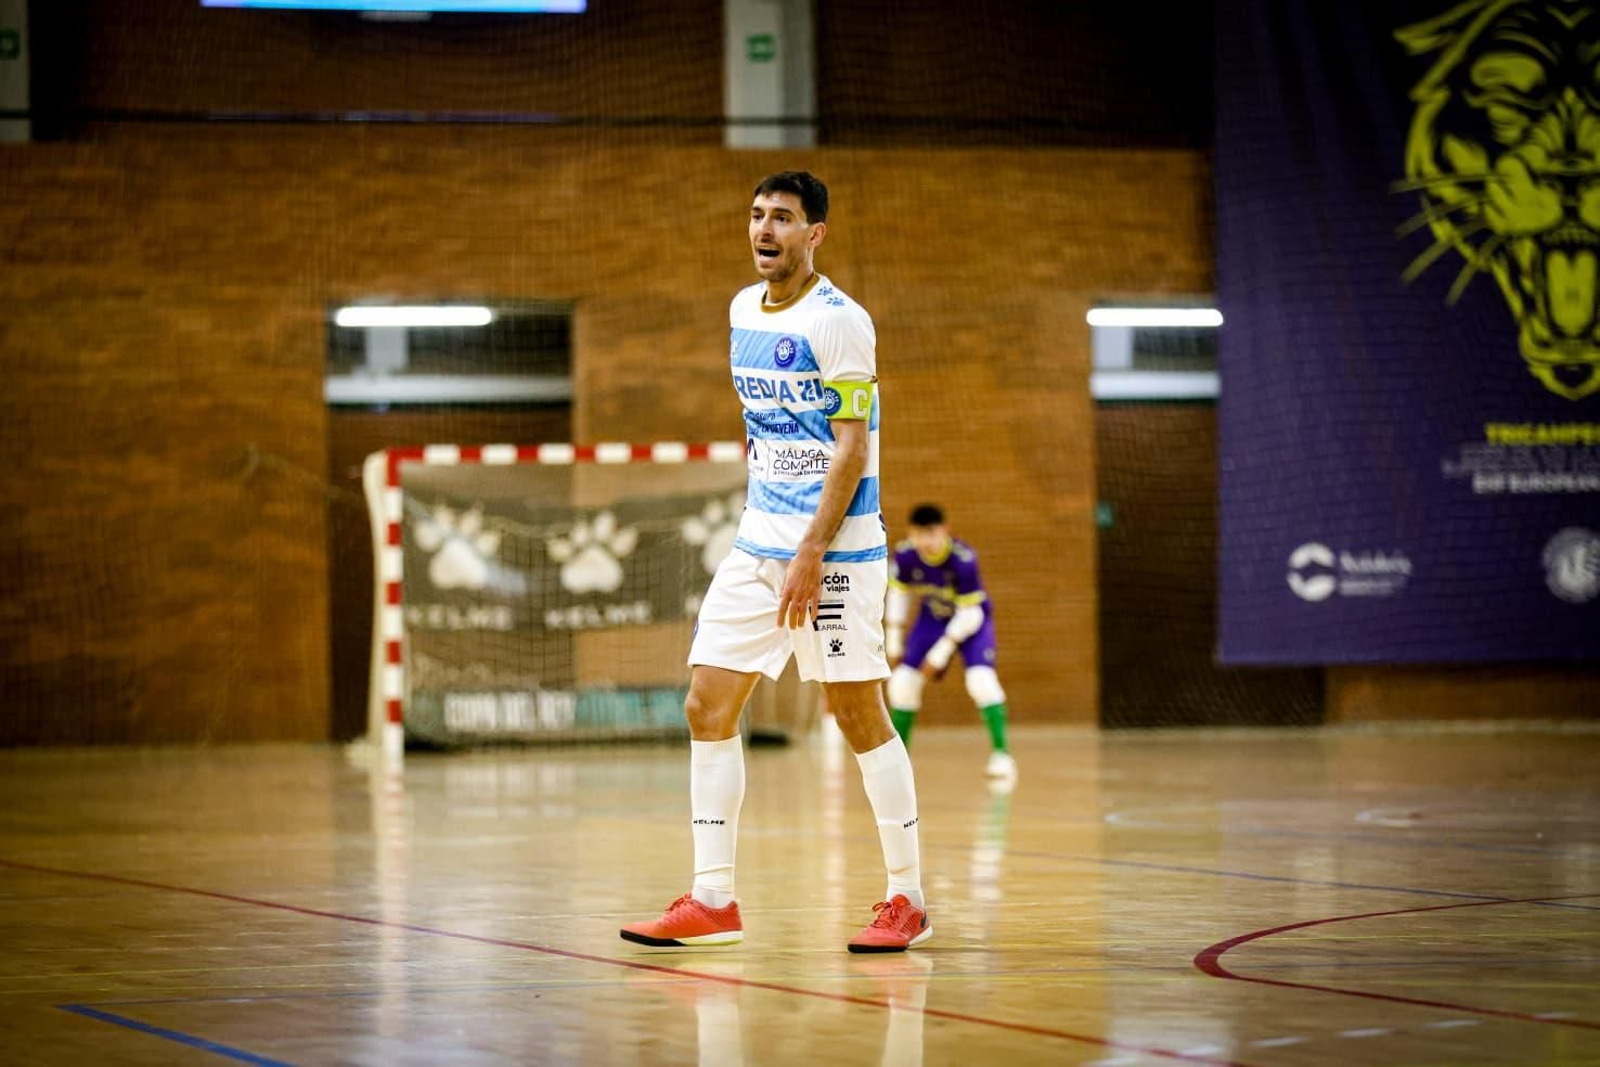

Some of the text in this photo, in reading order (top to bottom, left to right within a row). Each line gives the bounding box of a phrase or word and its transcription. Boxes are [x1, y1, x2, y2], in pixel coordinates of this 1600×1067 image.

[852, 388, 868, 417] C
[775, 447, 825, 460] MÁLAGA
[773, 457, 830, 471] COMPITE
[826, 585, 850, 594] viajes
[546, 601, 651, 630] KELME
[693, 818, 726, 826] KELME
